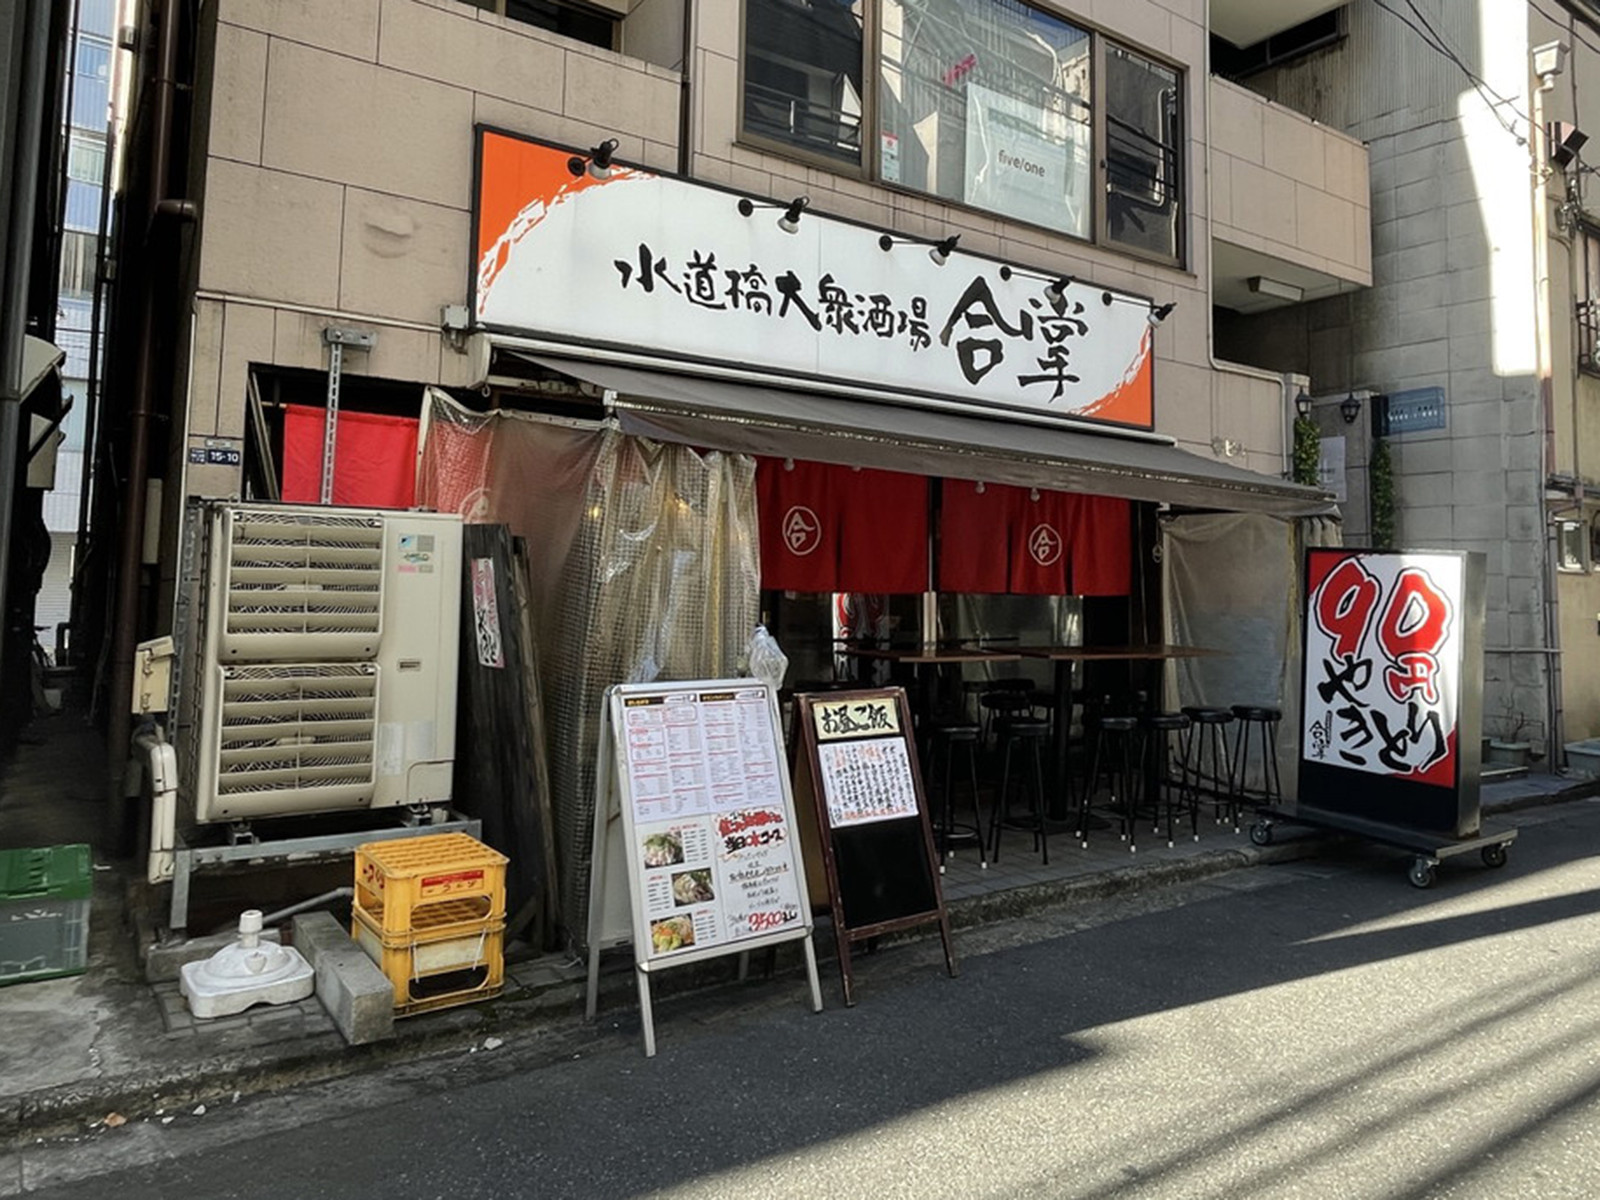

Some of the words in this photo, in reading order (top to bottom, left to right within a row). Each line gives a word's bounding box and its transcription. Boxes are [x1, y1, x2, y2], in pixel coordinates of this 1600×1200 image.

[997, 150, 1045, 177] five/one
[614, 243, 932, 352] 水道橋大衆酒場
[210, 451, 239, 463] 15-10
[821, 703, 894, 734] お昼ご飯
